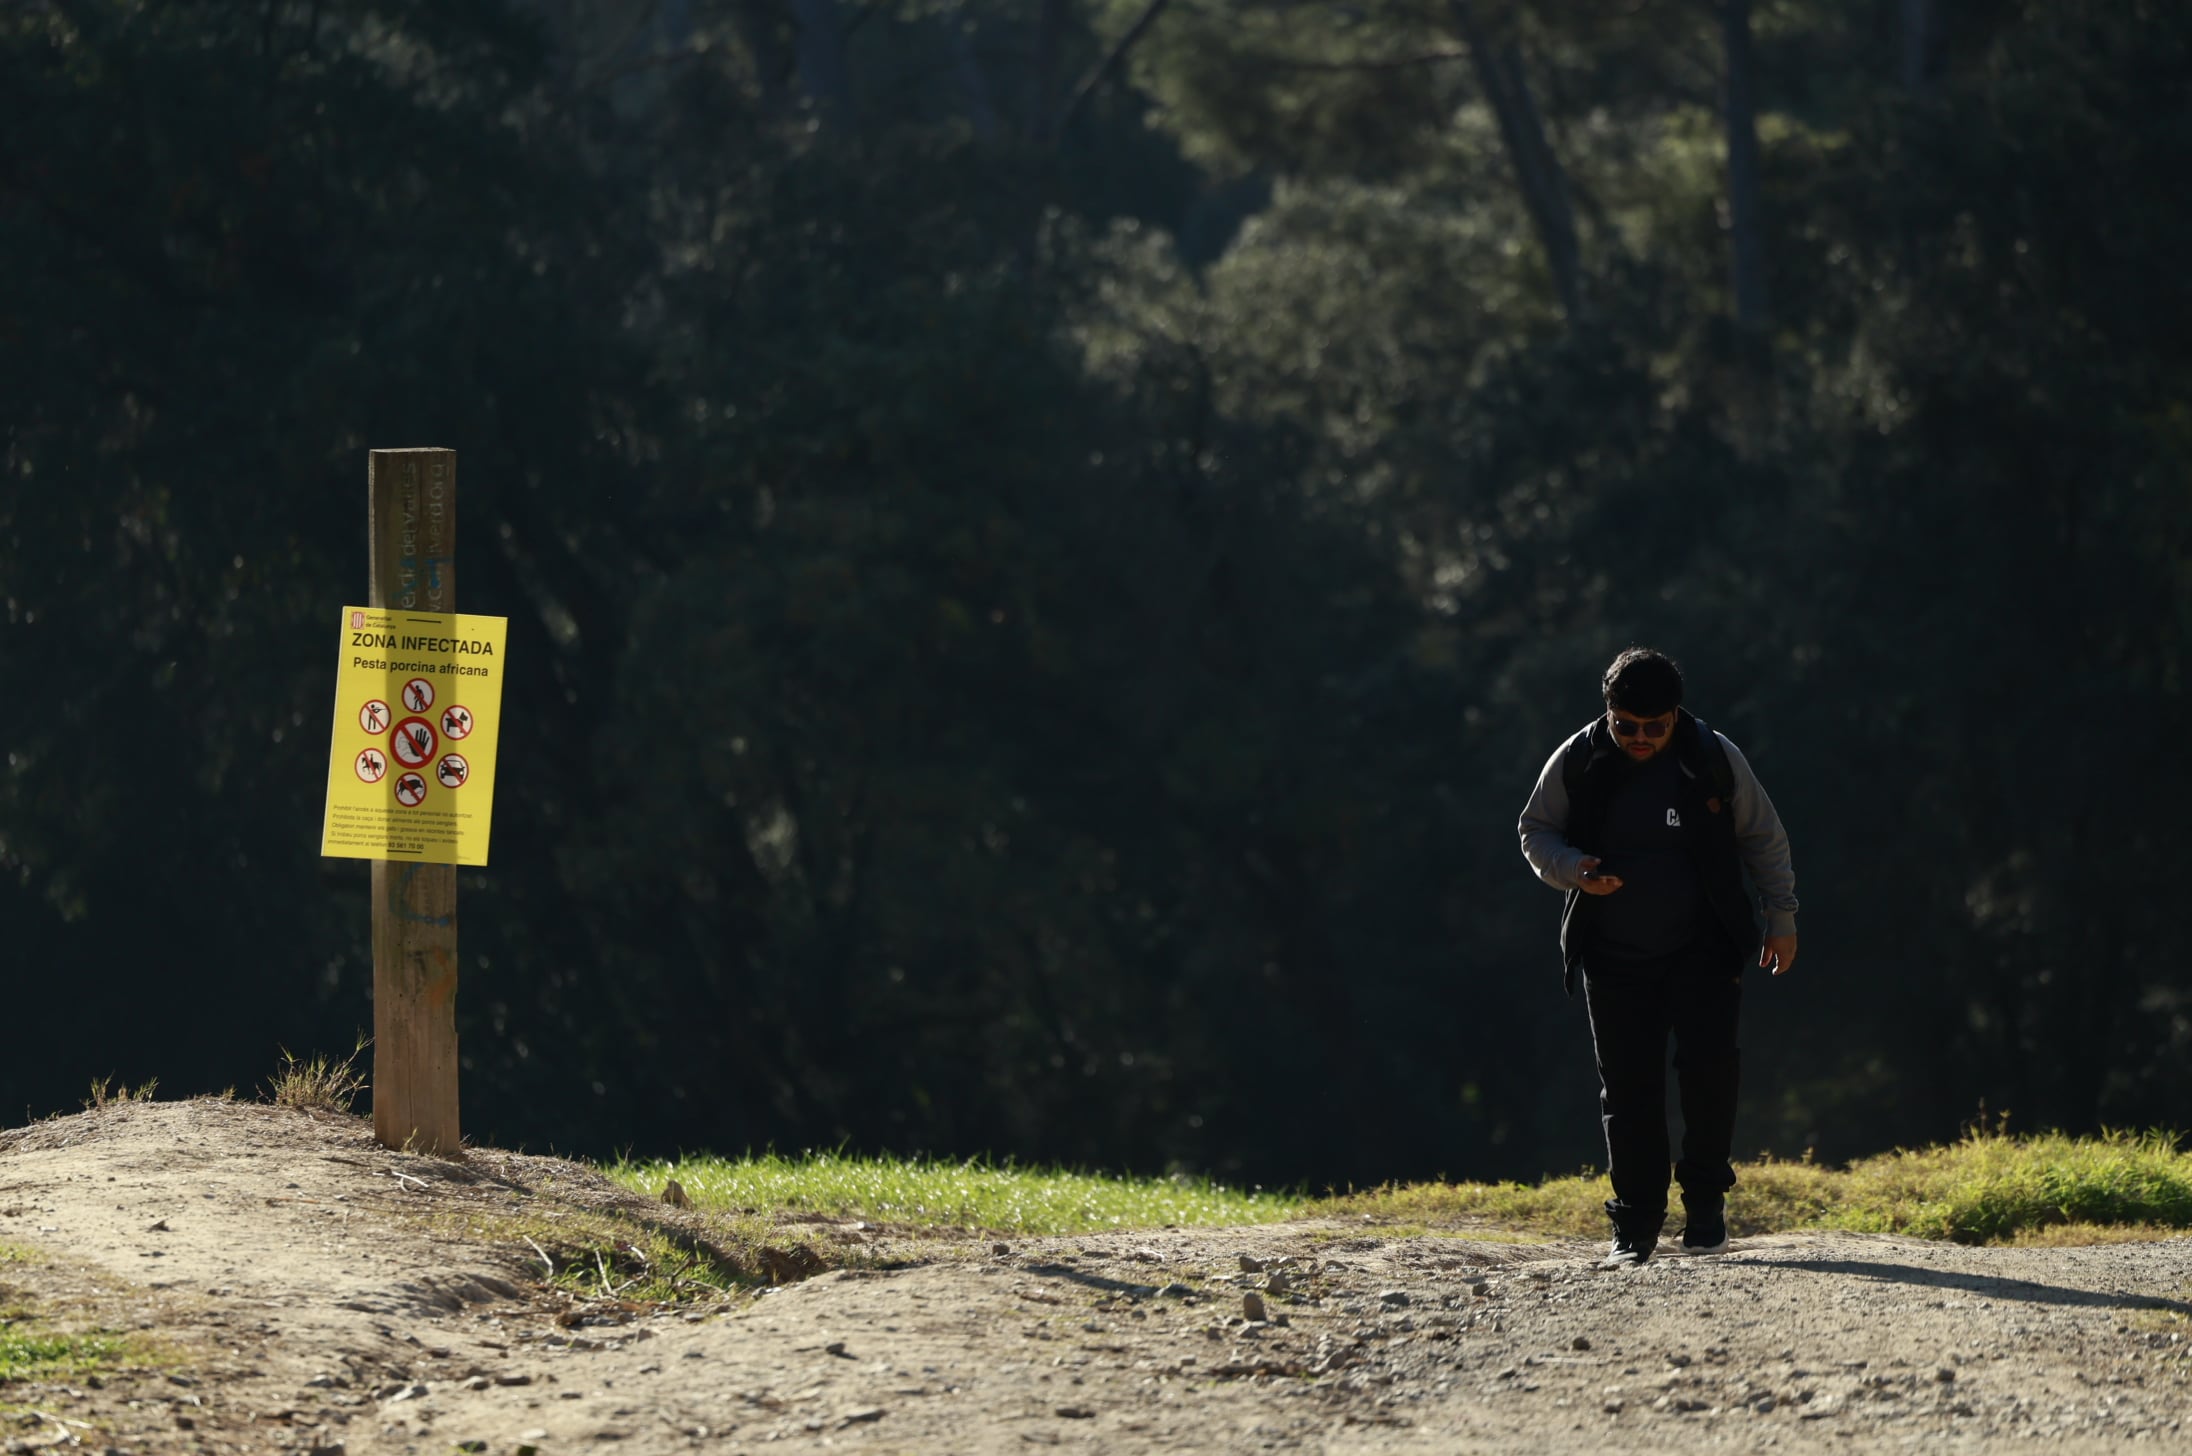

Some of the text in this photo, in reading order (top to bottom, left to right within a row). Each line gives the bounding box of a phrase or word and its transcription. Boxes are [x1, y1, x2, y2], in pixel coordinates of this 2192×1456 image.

[352, 633, 493, 654] ZONA INFECTADA
[354, 656, 488, 676] Pesta porcina africana
[1666, 807, 1681, 827] CA
